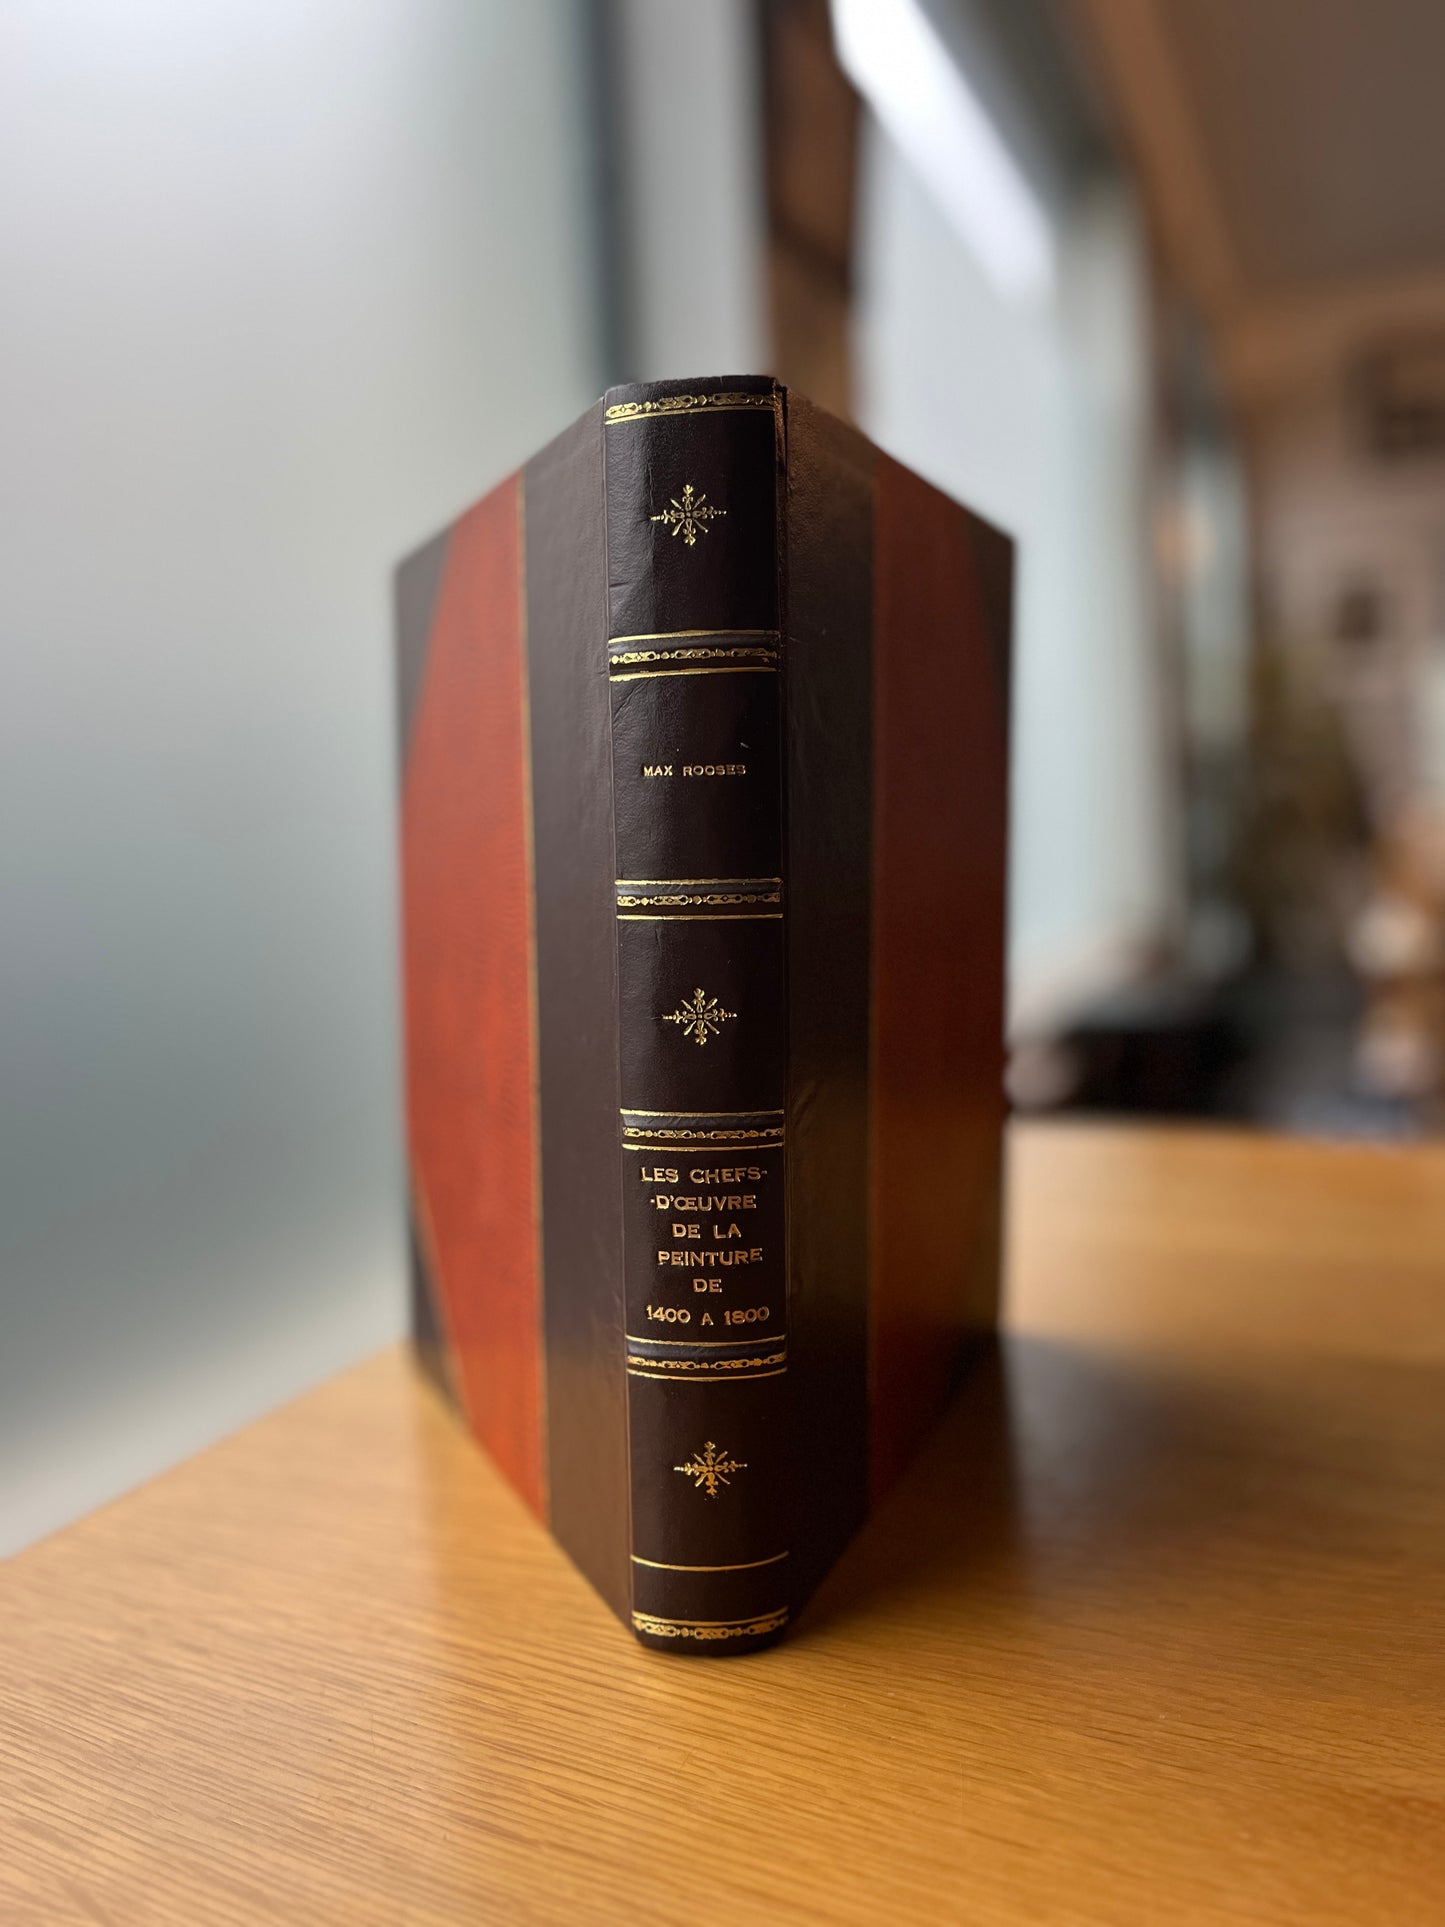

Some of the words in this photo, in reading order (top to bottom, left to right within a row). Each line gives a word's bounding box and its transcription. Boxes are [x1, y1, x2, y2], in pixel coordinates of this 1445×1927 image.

[643, 765, 673, 777] MAX
[683, 764, 746, 776] ROOSES
[641, 1167, 679, 1183] LES
[689, 1167, 768, 1184] CHEFS-
[672, 1223, 701, 1239] DE
[713, 1223, 742, 1239] LA
[657, 1248, 763, 1267] PEINTURE
[693, 1278, 722, 1293] DE
[646, 1304, 691, 1323] 1400
[701, 1312, 714, 1326] A
[724, 1306, 770, 1325] 1800
